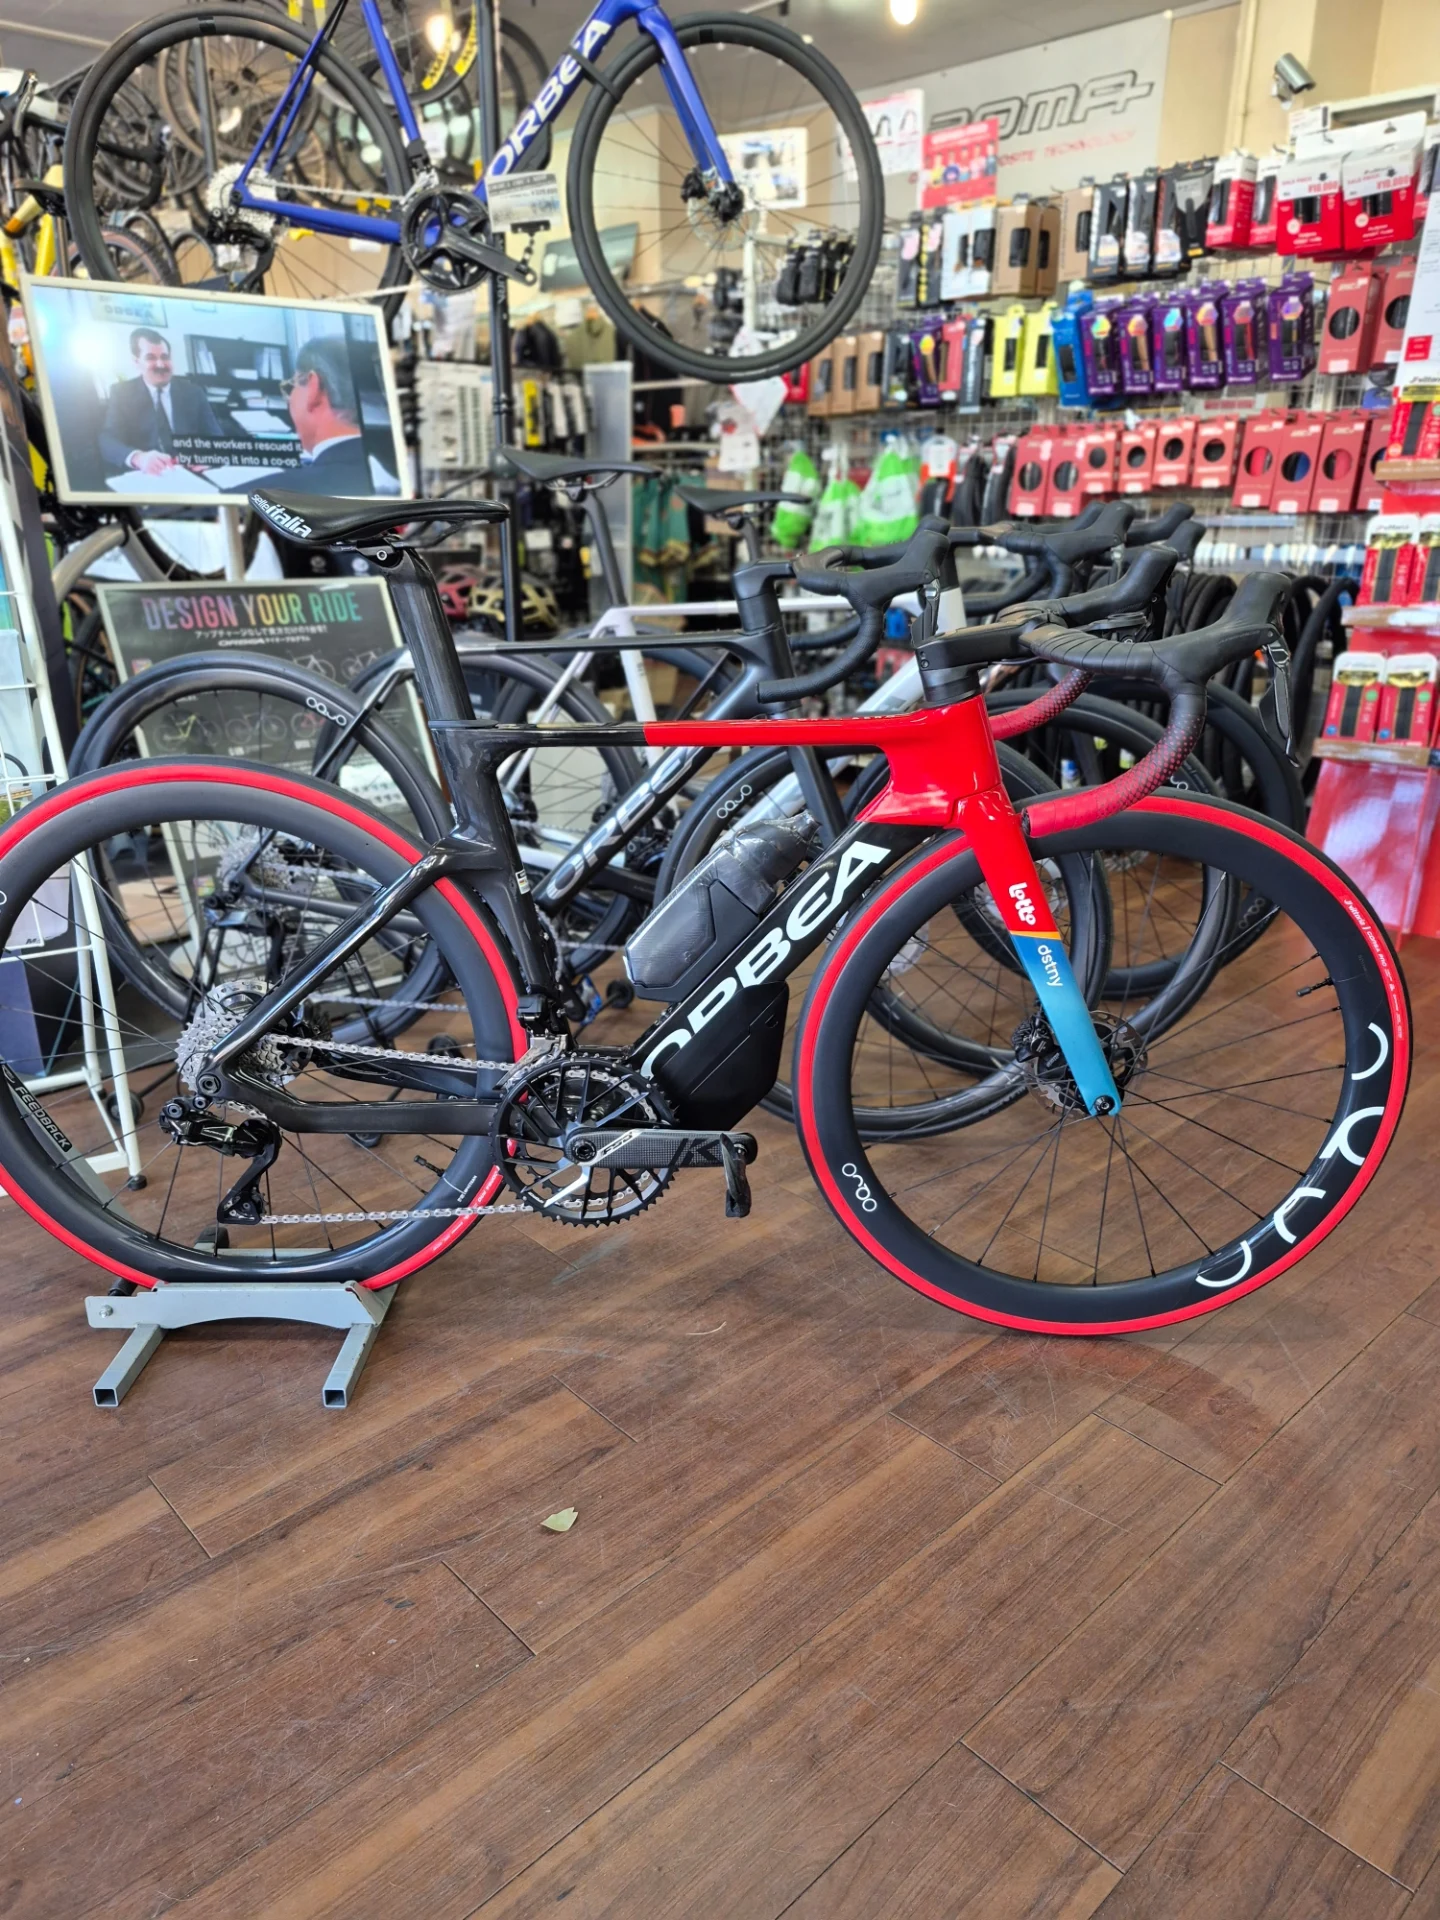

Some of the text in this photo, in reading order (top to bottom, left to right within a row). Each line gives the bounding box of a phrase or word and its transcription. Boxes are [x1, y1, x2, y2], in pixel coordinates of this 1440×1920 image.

[173, 438, 192, 448] and
[194, 438, 211, 448] the
[213, 439, 253, 450] workers
[254, 440, 293, 452] rescued
[179, 454, 191, 465] by
[193, 454, 230, 466] turning
[231, 455, 239, 465] it
[241, 455, 260, 466] into
[251, 494, 312, 538] selle italia
[142, 591, 363, 630] DESIGN YOUR RIDE
[1037, 944, 1063, 987] dstny
[15, 1086, 70, 1149] FEEDBACK
